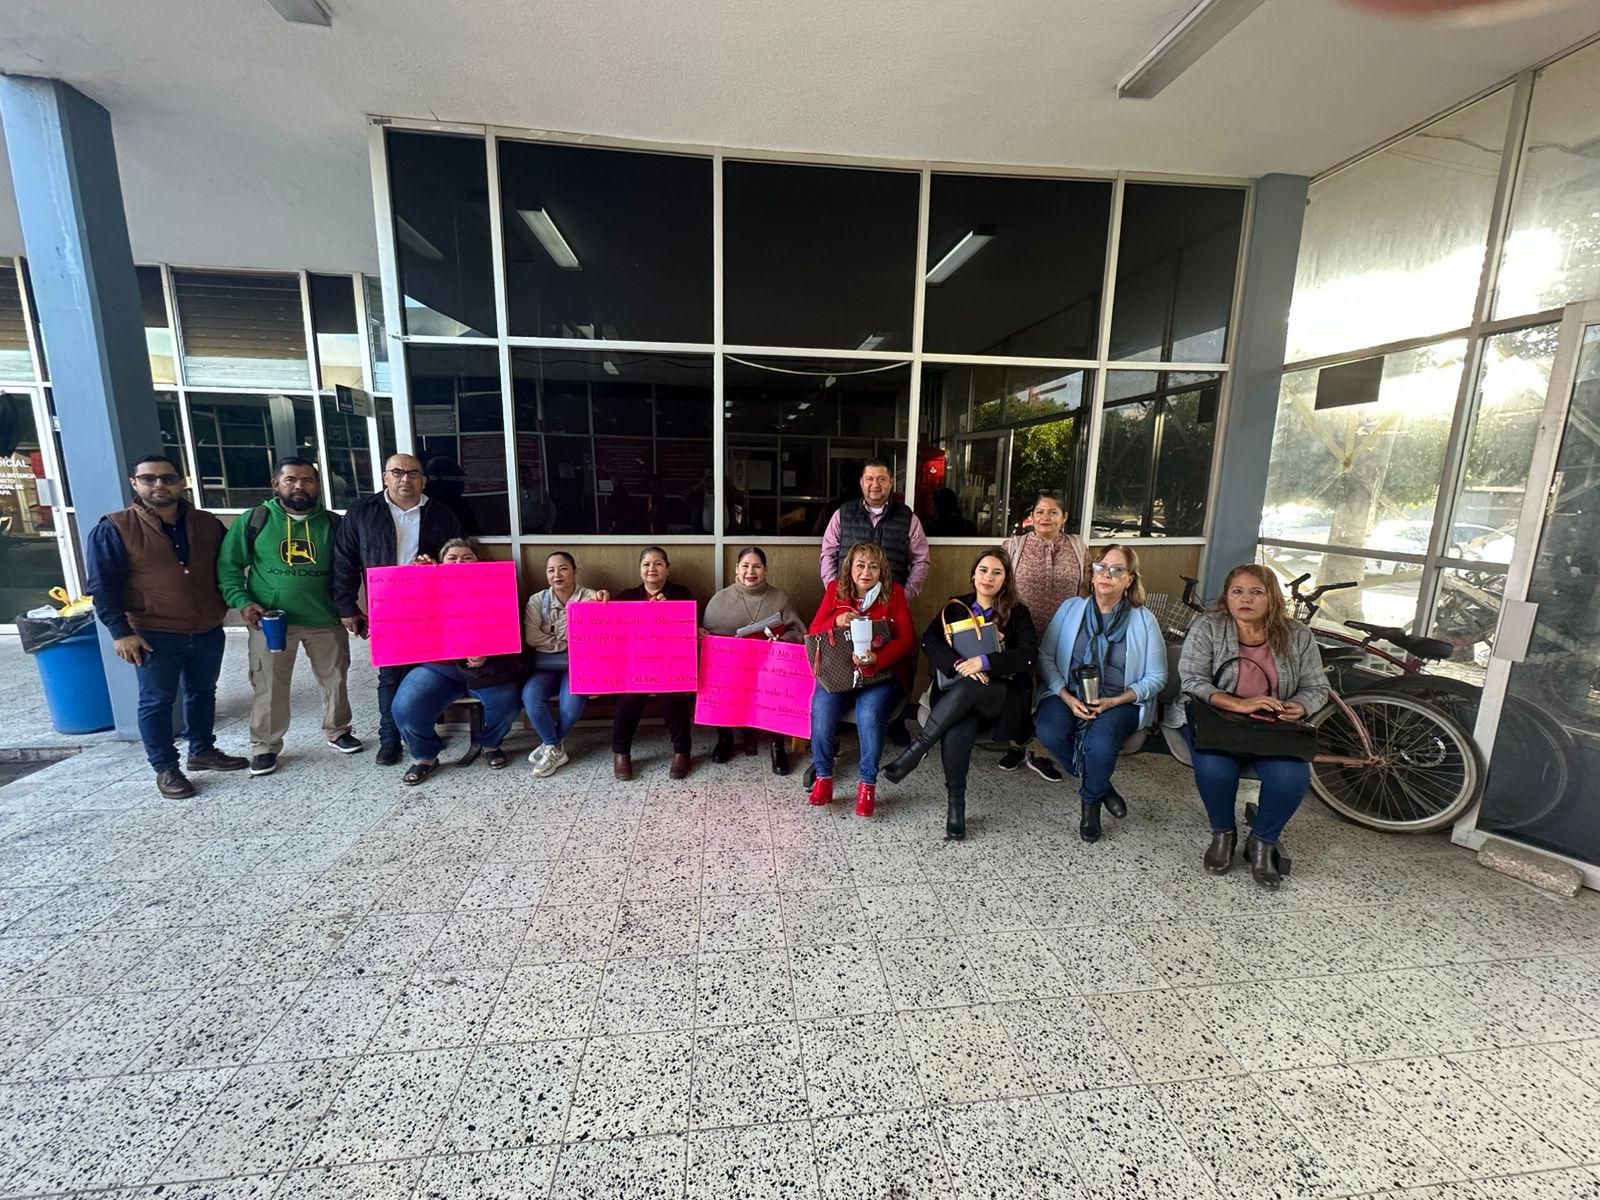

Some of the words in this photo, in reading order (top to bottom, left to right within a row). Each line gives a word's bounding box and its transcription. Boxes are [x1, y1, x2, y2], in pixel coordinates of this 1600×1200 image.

[267, 566, 297, 577] JOHN
[569, 609, 584, 625] La
[778, 650, 789, 659] NO
